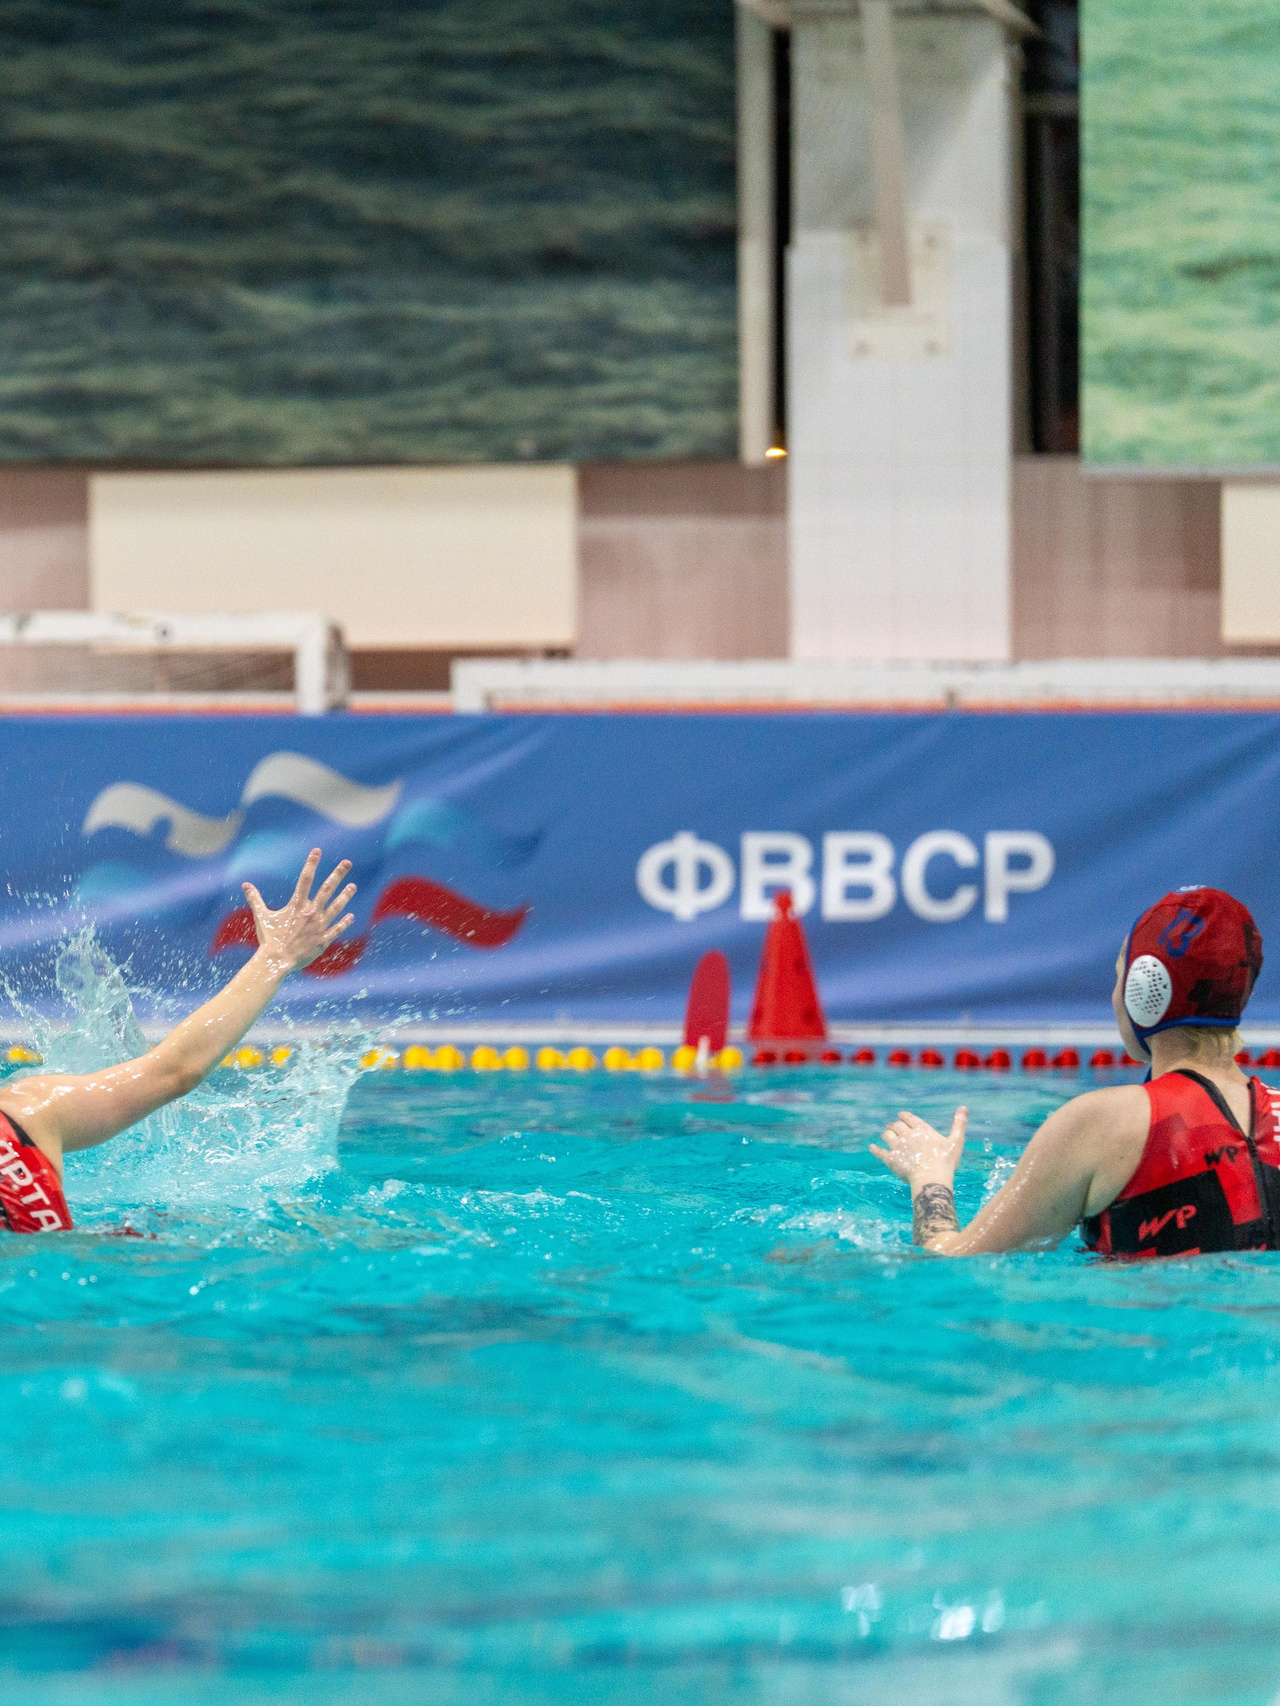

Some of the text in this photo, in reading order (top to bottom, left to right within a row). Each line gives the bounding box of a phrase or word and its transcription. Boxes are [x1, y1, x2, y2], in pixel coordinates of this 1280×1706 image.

[635, 829, 1056, 923] ФВВСР
[1157, 909, 1206, 959] 13
[1138, 1204, 1197, 1242] WP
